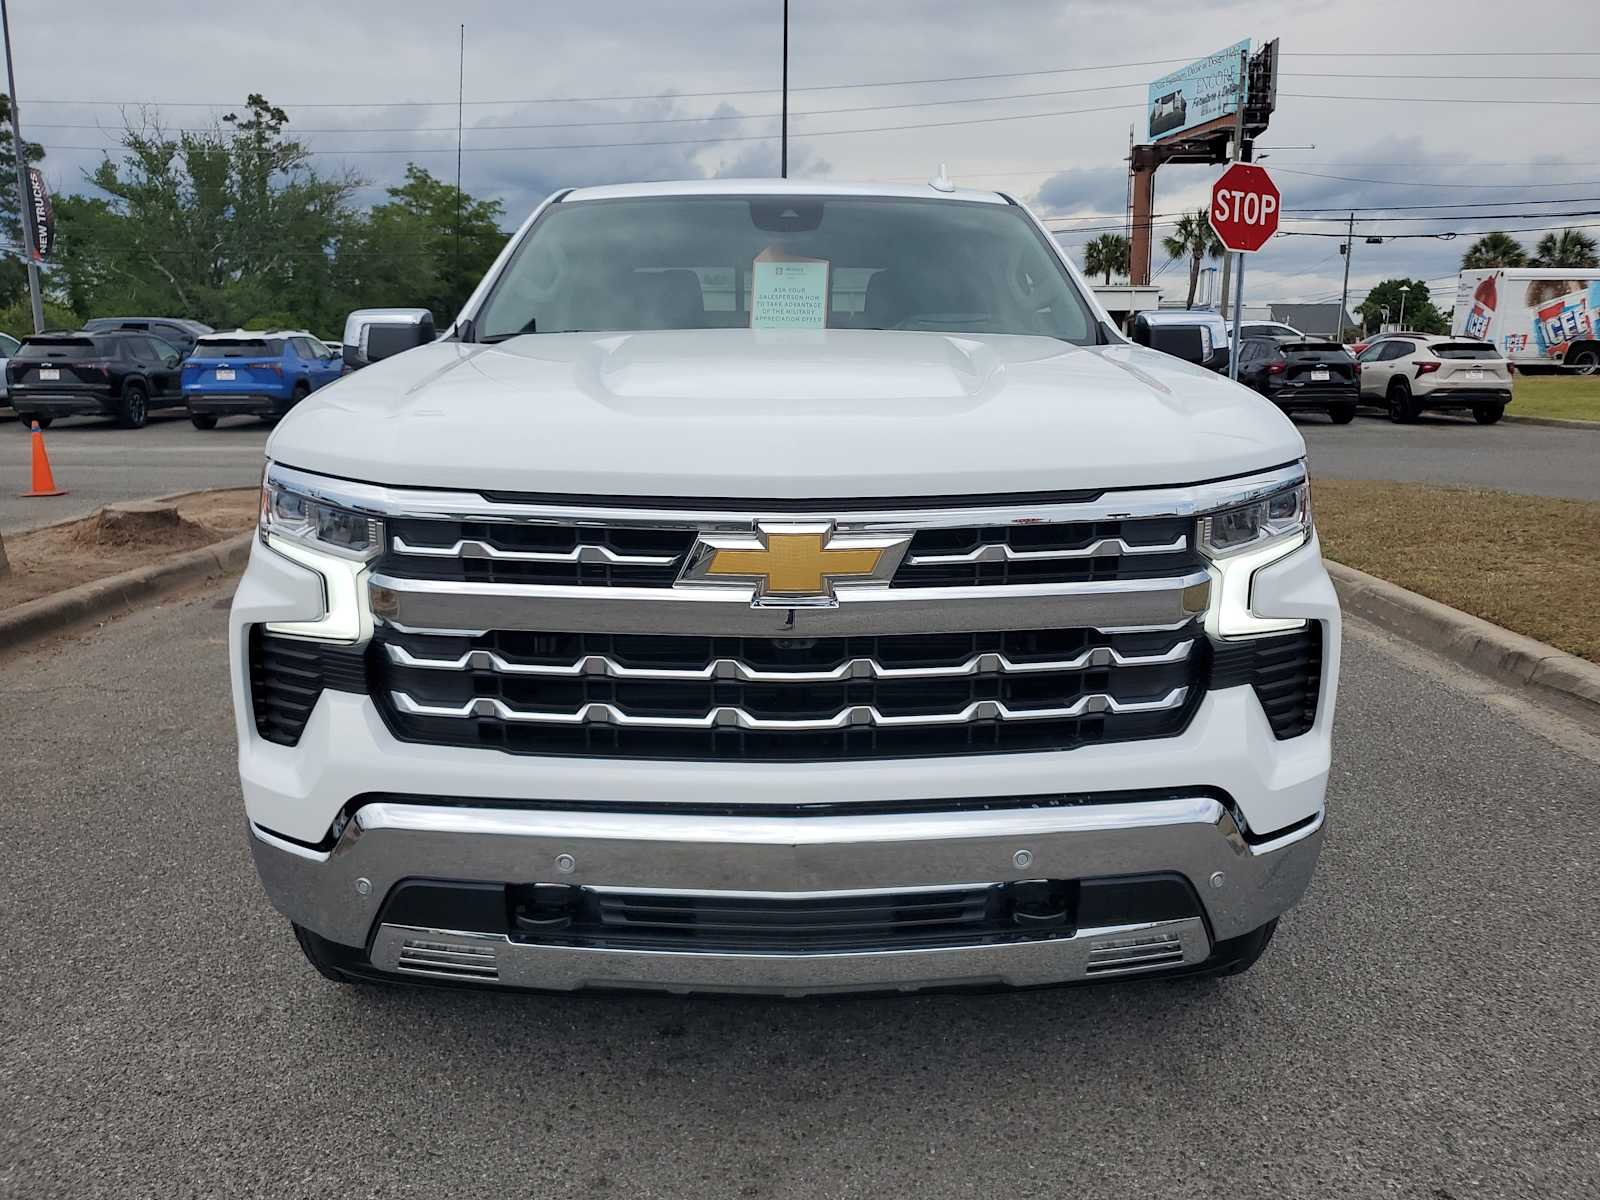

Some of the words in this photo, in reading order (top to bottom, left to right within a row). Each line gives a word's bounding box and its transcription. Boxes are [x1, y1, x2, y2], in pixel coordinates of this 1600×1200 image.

[30, 172, 46, 223] TRUCKS
[1215, 189, 1277, 225] STOP
[38, 224, 48, 253] NEW
[1468, 316, 1488, 338] ICEE
[1507, 336, 1525, 348] ICEE
[1541, 312, 1588, 345] ICEE
